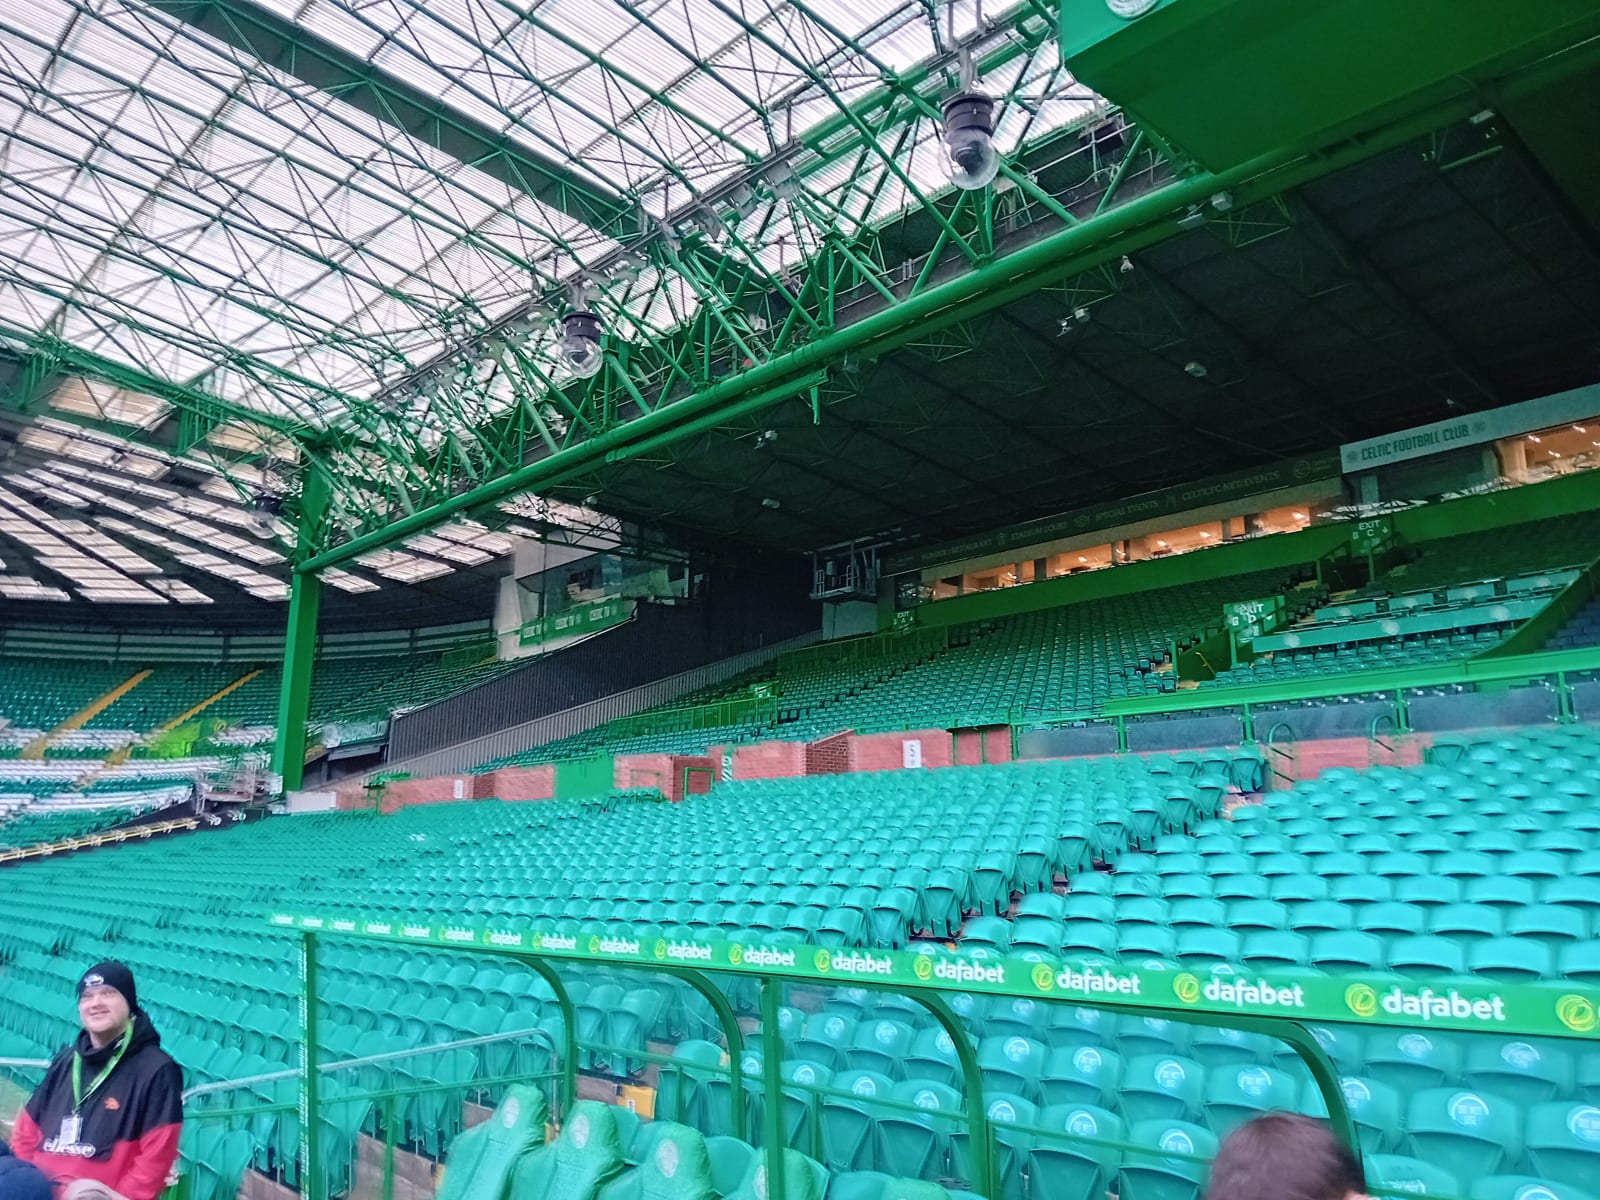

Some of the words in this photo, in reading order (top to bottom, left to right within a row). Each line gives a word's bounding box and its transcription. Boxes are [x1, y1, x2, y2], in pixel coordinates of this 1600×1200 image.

[1361, 442, 1392, 460] CELTIC
[1393, 431, 1441, 453] FOOTBALL
[1442, 424, 1470, 441] CLUB
[1358, 520, 1381, 530] EXIT
[1366, 529, 1375, 537] C
[1239, 603, 1264, 615] EXIT
[599, 937, 640, 955] dafabet
[666, 942, 712, 961] dafabet
[743, 947, 795, 968] dafabet
[832, 952, 892, 976] dafabet
[934, 959, 1004, 984] dafabet
[1056, 966, 1140, 996] dafabet
[1203, 975, 1304, 1007] dafabet
[1381, 986, 1505, 1021] dafabet
